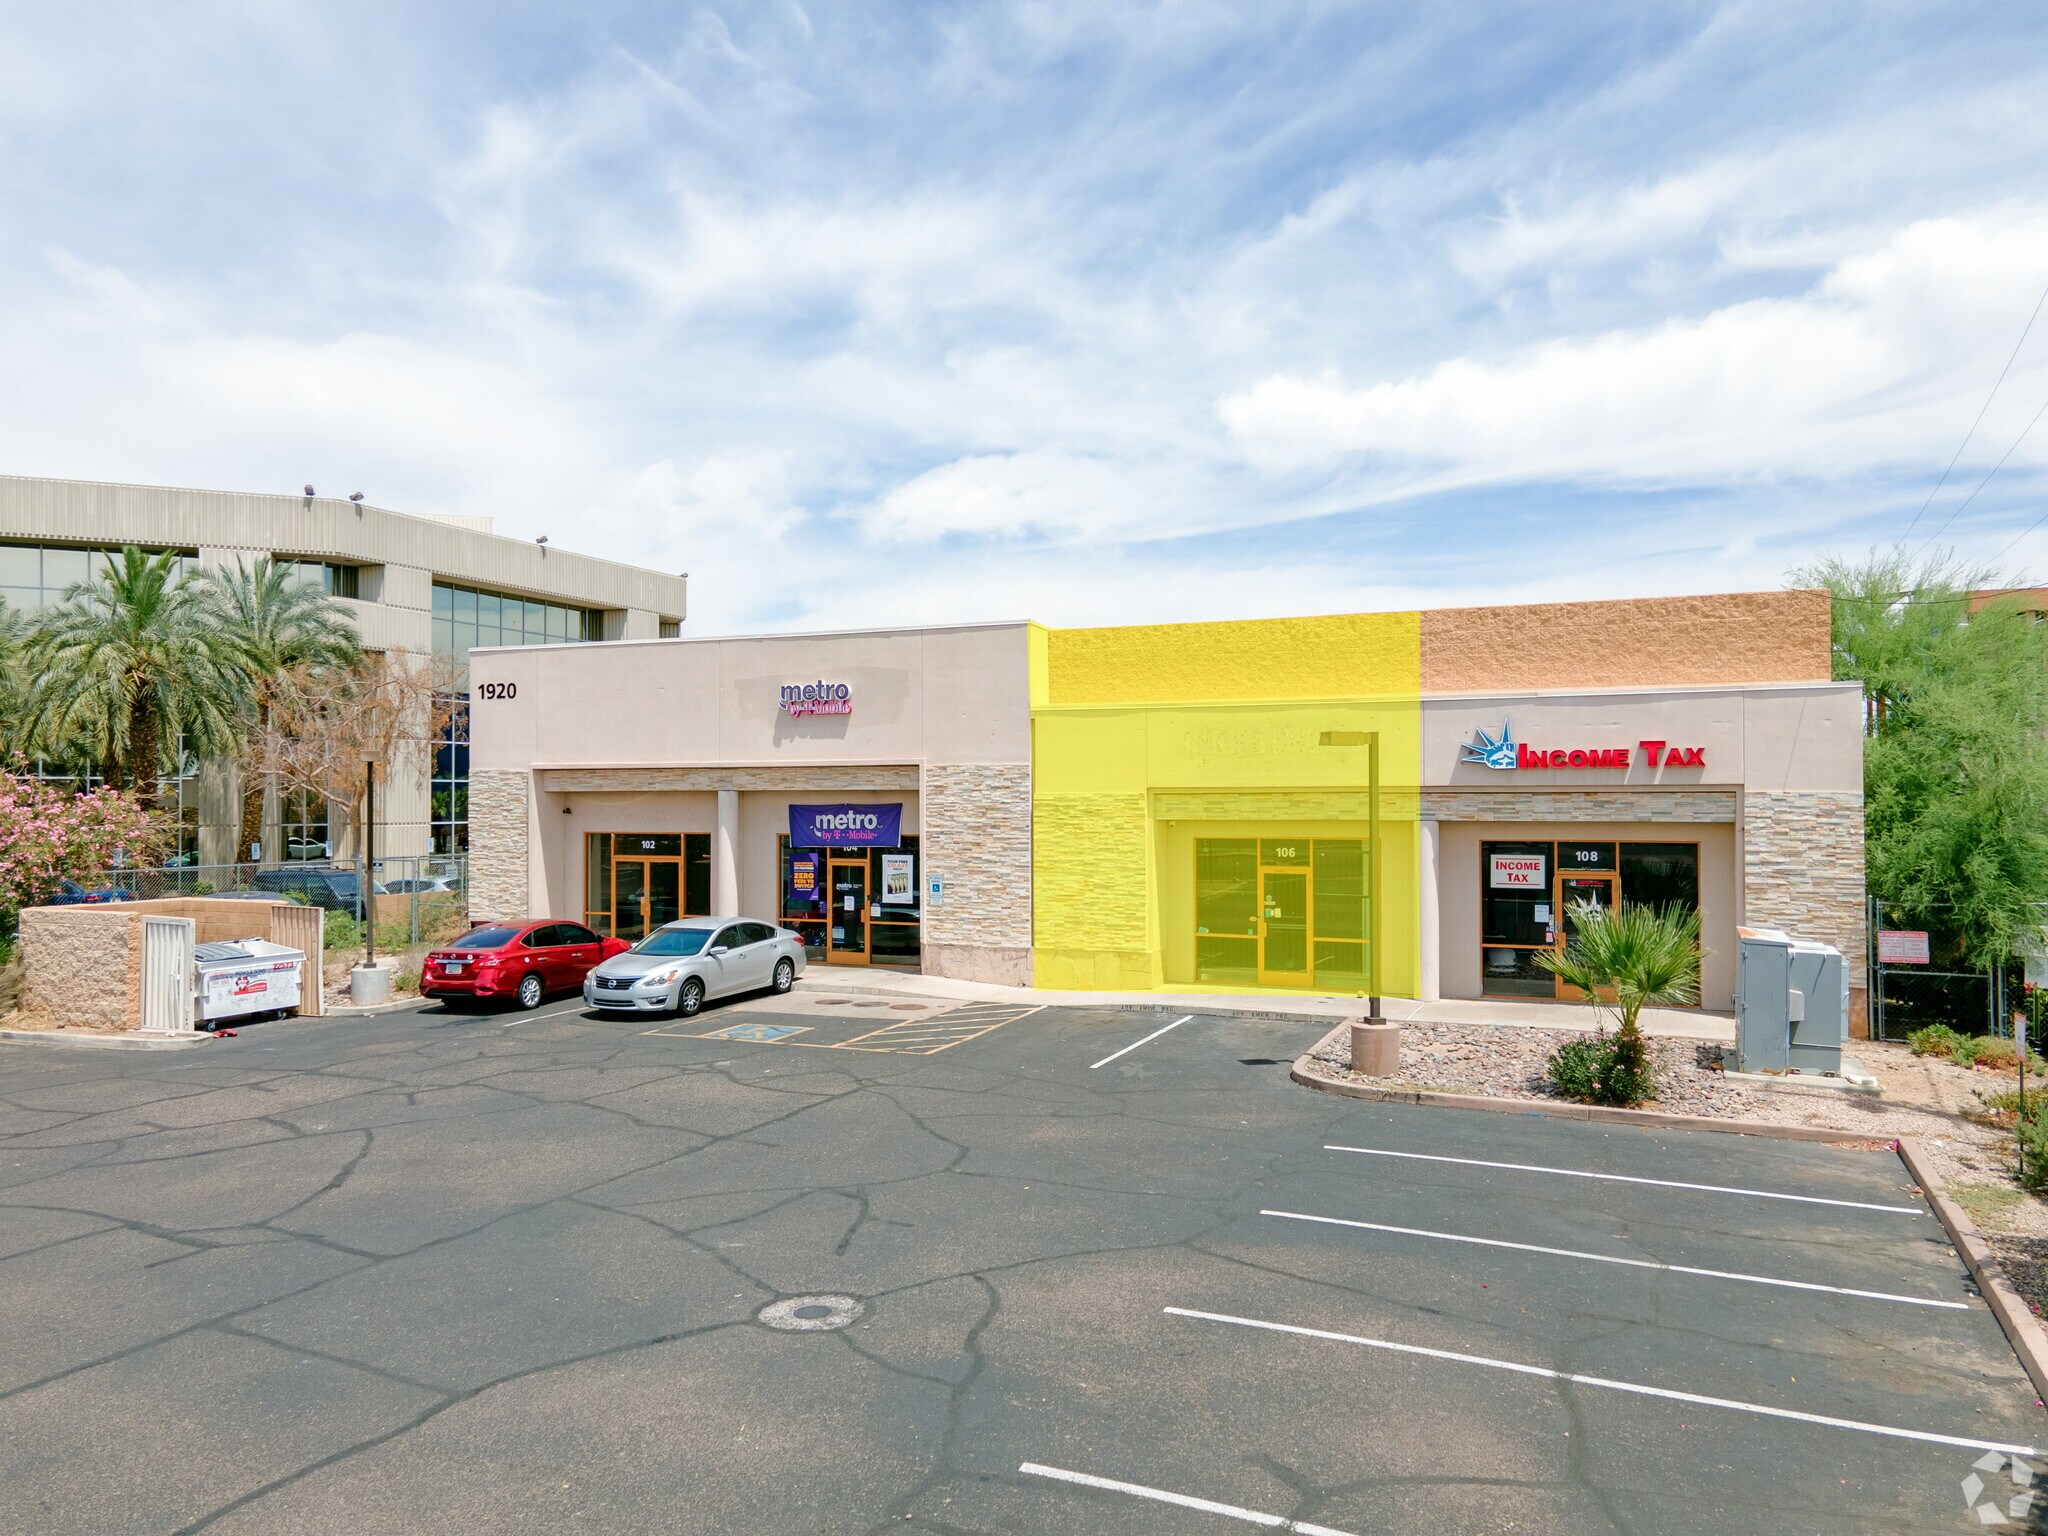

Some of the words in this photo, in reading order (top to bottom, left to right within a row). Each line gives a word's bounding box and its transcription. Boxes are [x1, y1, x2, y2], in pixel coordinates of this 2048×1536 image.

[478, 682, 517, 700] 1920
[779, 679, 852, 702] metro
[1518, 743, 1630, 769] INCOME
[1639, 740, 1706, 768] TAX
[814, 810, 878, 832] metro
[822, 830, 832, 842] by
[641, 840, 656, 849] 102
[1275, 847, 1296, 858] 106
[1575, 850, 1599, 862] 108
[1495, 860, 1541, 871] INCOME
[1507, 872, 1529, 883] TAX
